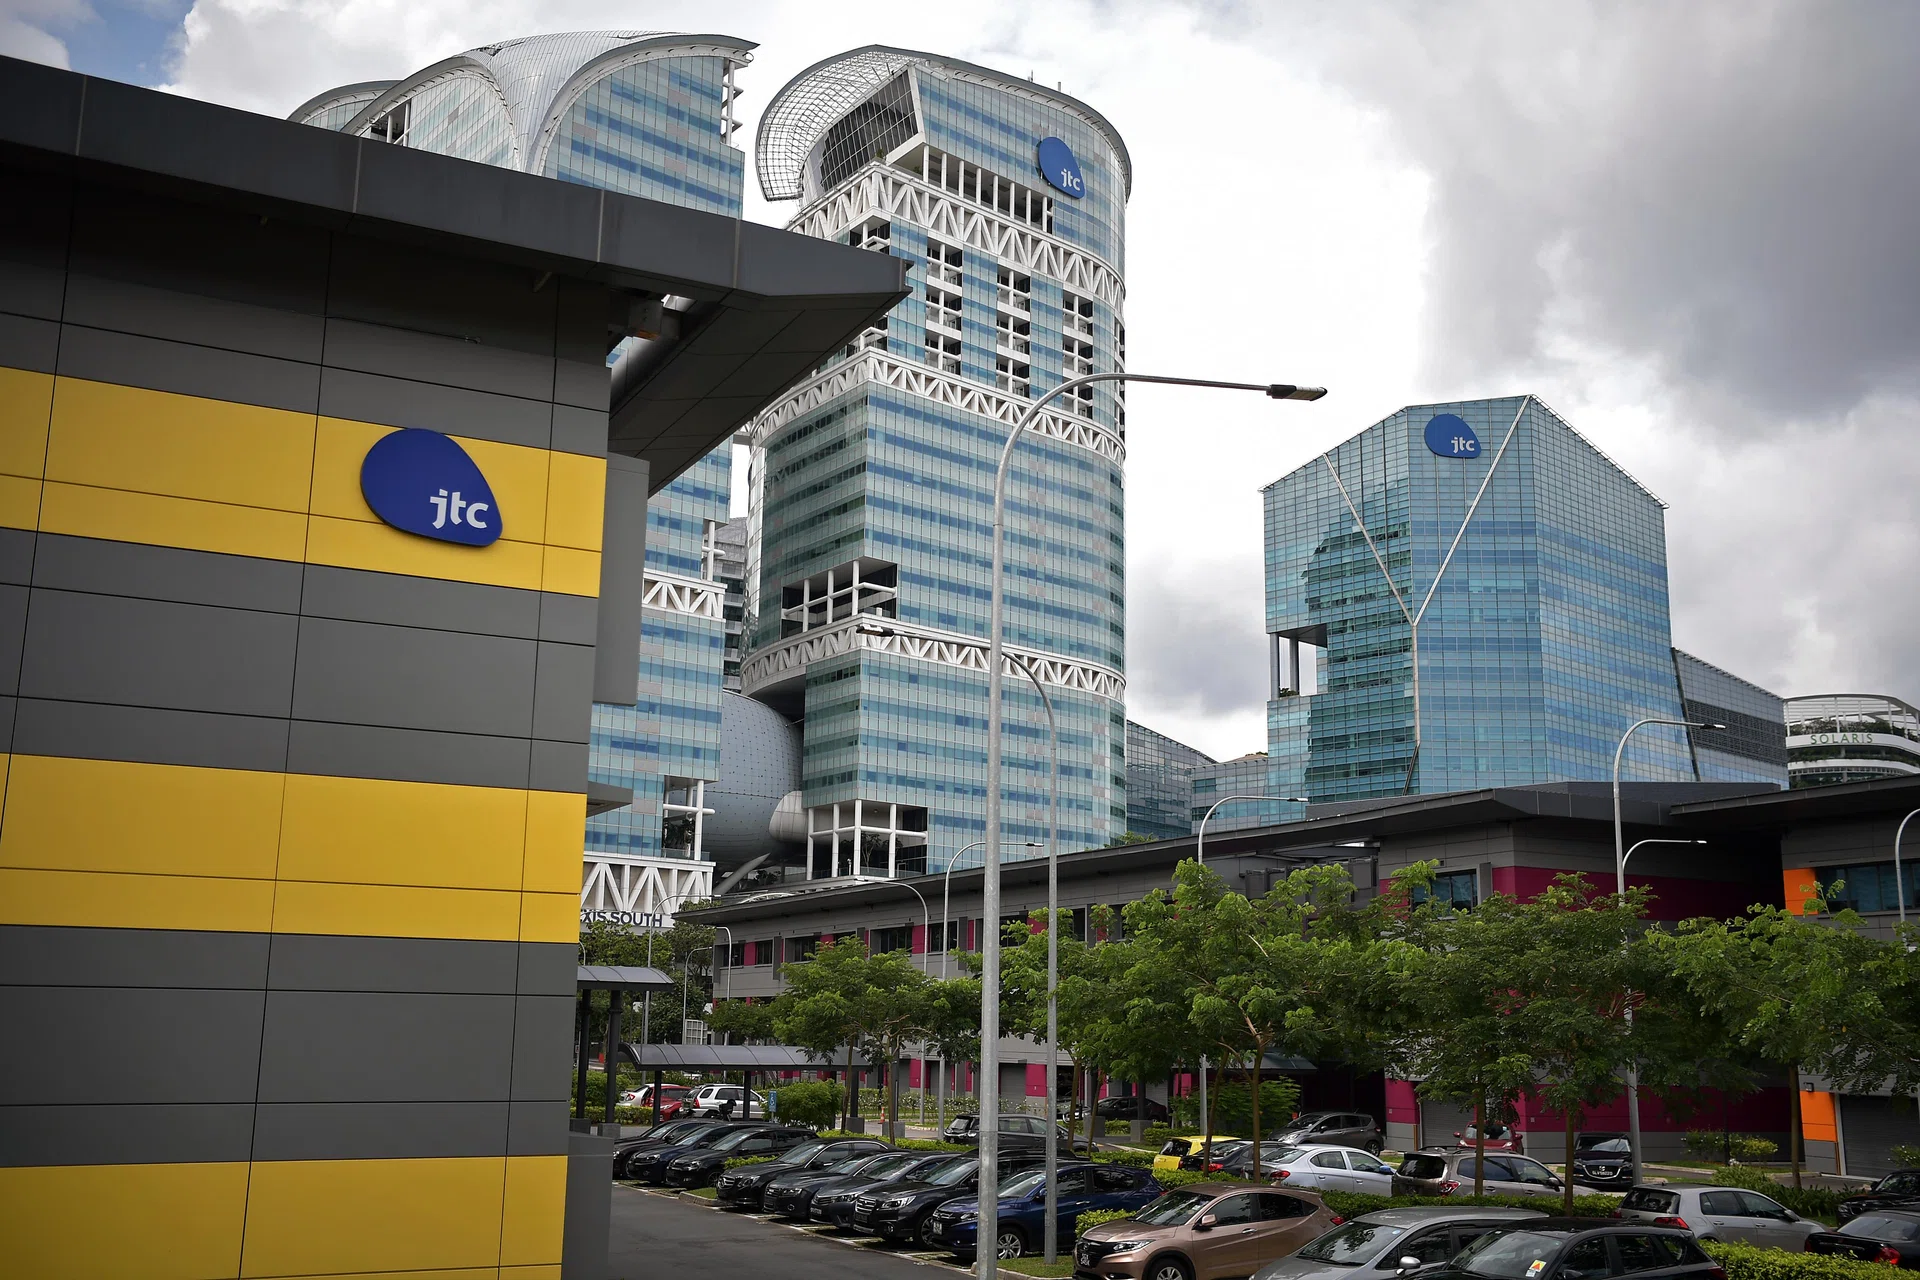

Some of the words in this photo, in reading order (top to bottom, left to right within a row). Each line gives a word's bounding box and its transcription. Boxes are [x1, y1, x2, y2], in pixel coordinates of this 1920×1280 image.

[1061, 168, 1080, 191] jtc
[1451, 437, 1475, 454] jtc
[430, 489, 489, 529] jtc
[1810, 733, 1873, 744] SOLARIS
[581, 909, 607, 923] XIS
[610, 911, 662, 927] SOUTH
